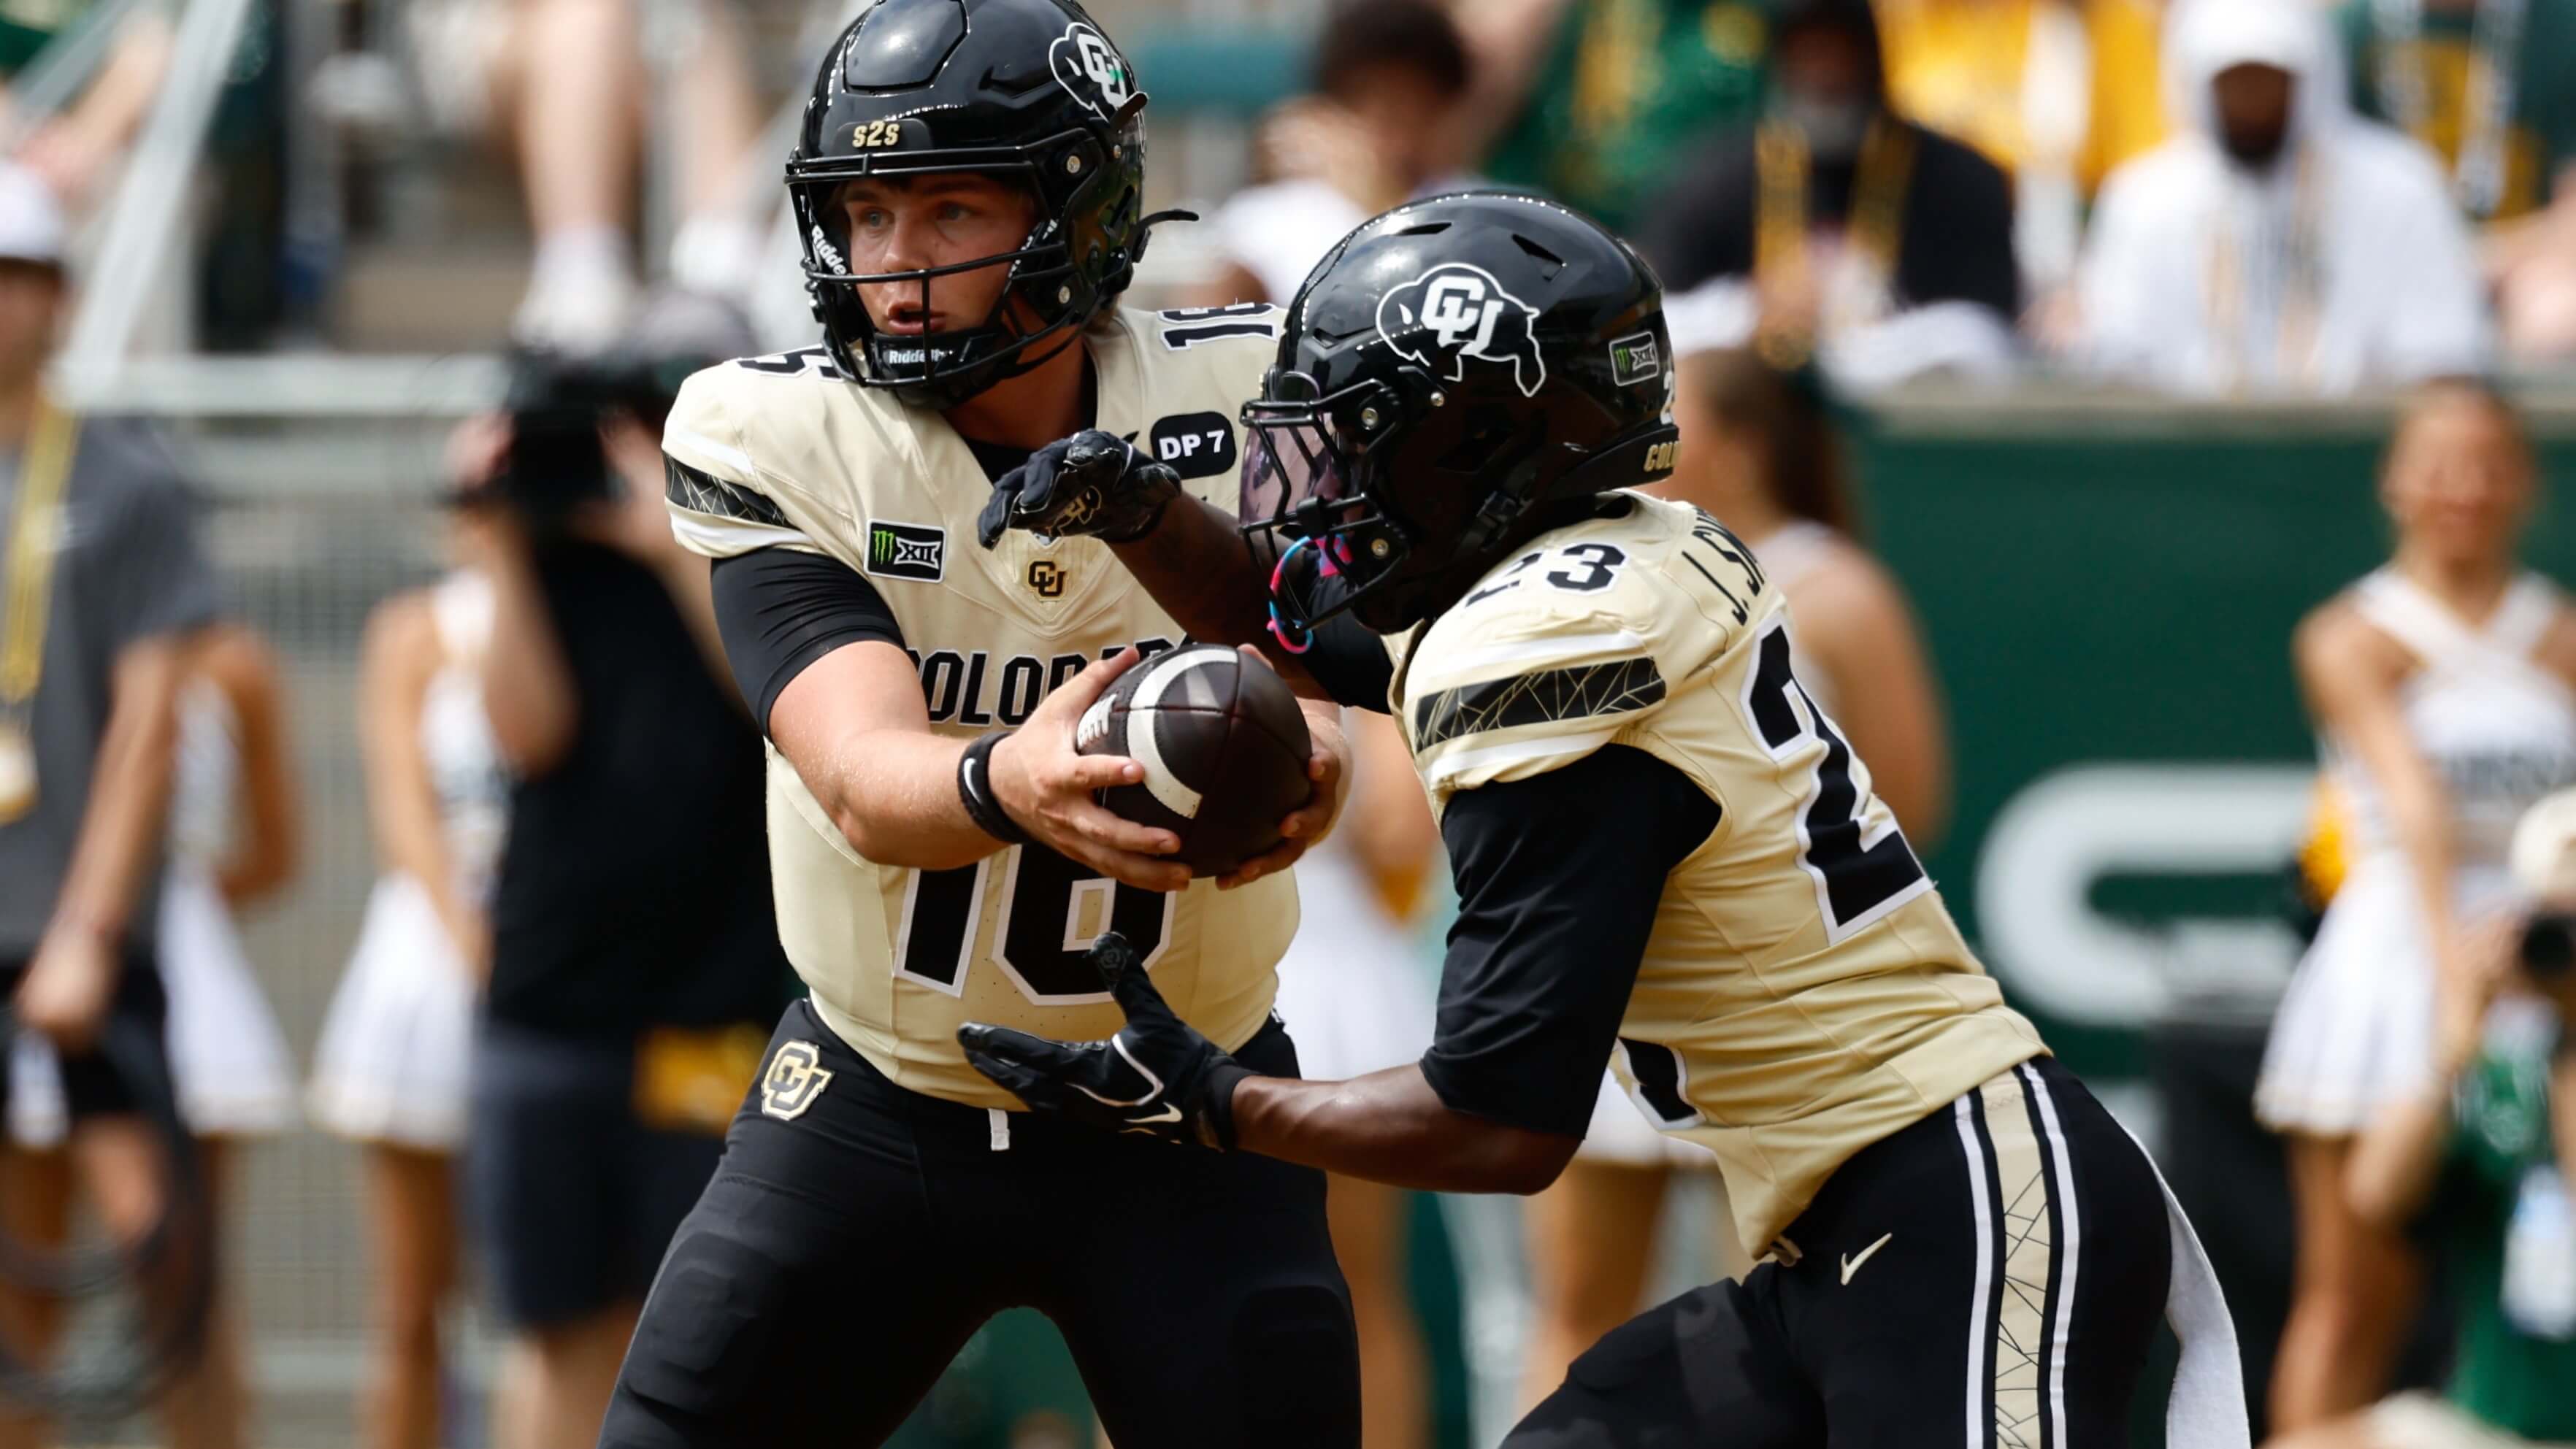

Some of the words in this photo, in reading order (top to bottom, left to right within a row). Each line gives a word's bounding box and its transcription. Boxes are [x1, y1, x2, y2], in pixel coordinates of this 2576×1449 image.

[1420, 275, 1504, 355] CU
[1159, 434, 1201, 461] DP
[1206, 429, 1224, 453] 7
[1028, 560, 1067, 597] CU
[762, 1042, 834, 1121] CU
